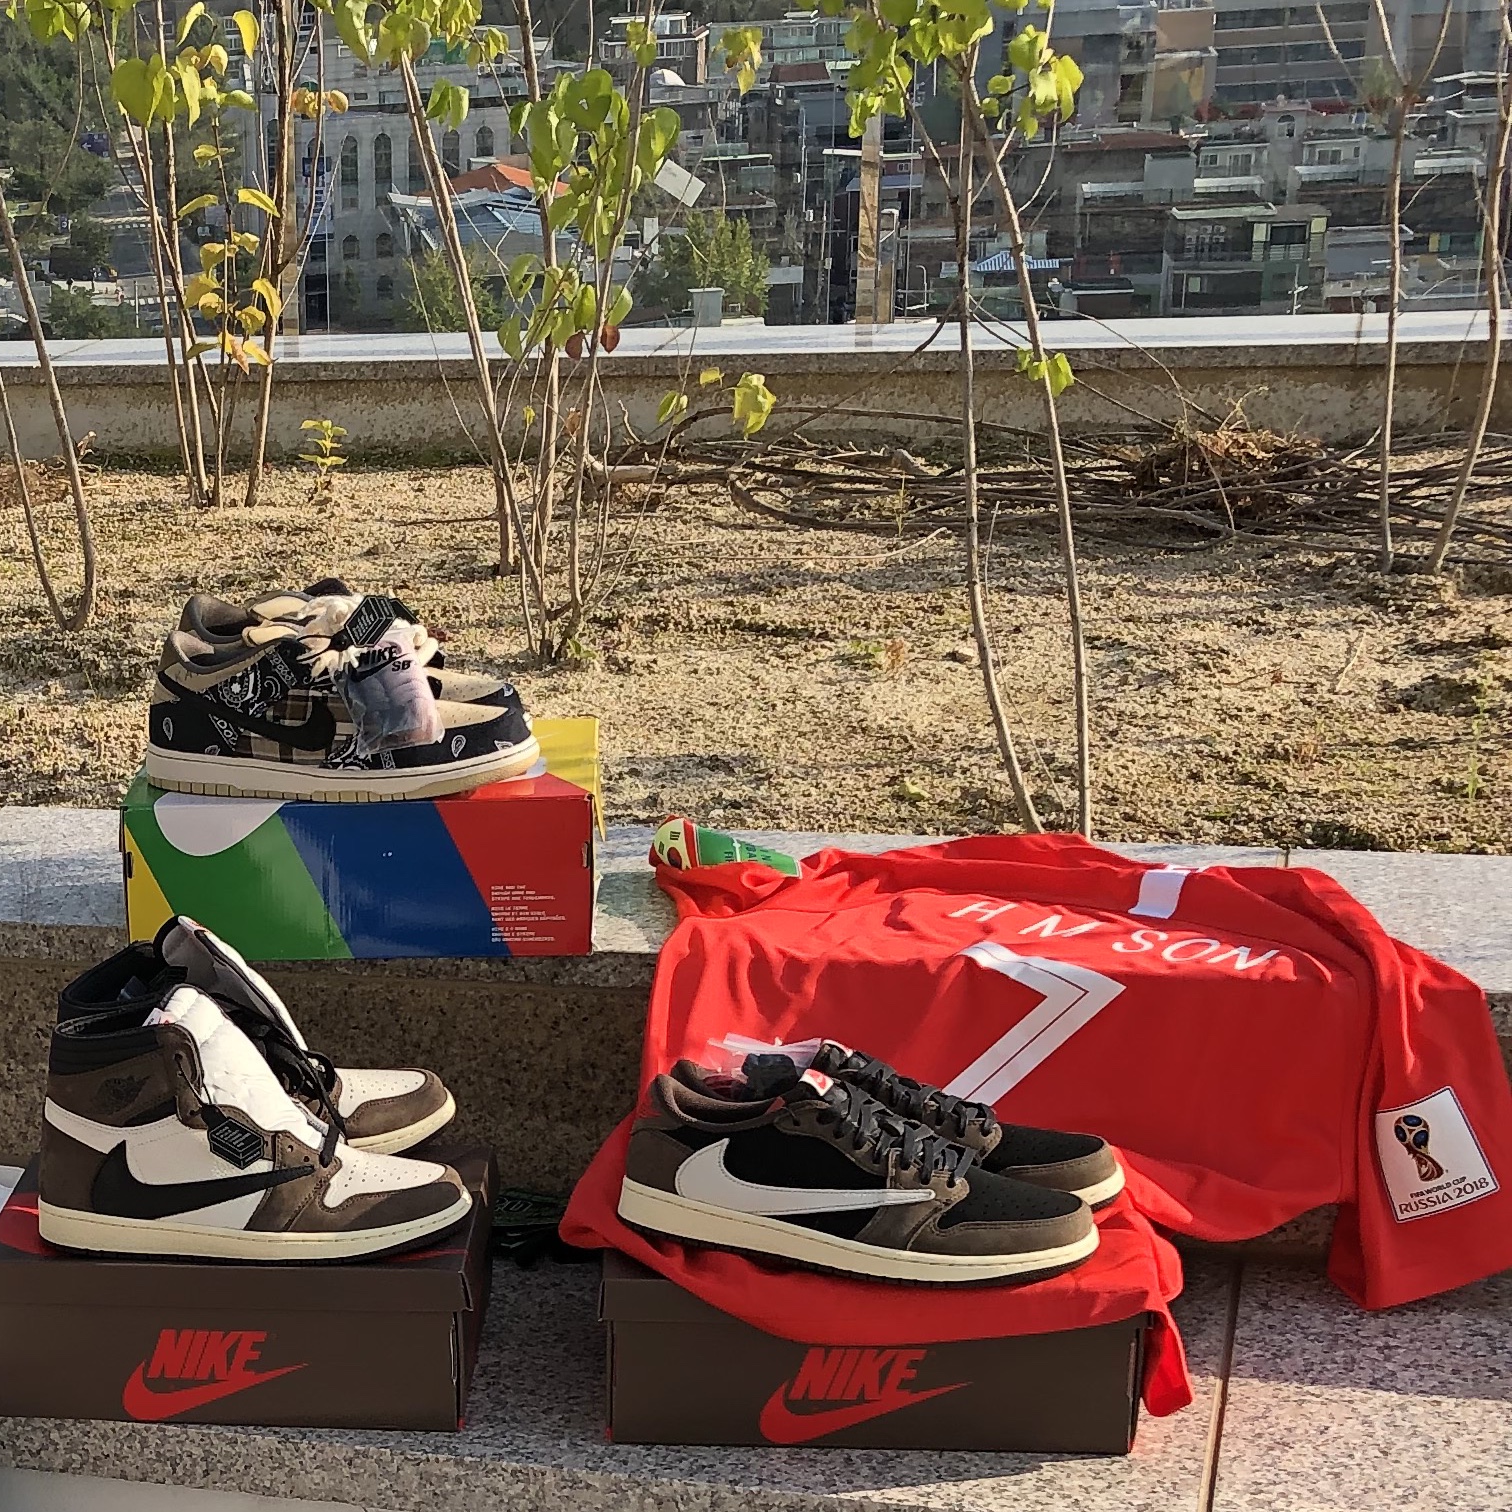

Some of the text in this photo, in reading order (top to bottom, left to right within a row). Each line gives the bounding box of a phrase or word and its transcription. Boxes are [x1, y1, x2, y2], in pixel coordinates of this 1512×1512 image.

[359, 645, 398, 666] NIKE
[391, 660, 412, 672] SB
[1111, 928, 1283, 972] SON
[940, 939, 1128, 1110] 7
[1398, 1176, 1490, 1215] RUSSIA 2018
[1409, 1190, 1426, 1199] FIFA
[1424, 1181, 1452, 1195] WORLD
[147, 1329, 267, 1380] NIKE
[788, 1347, 927, 1401] NIKE
